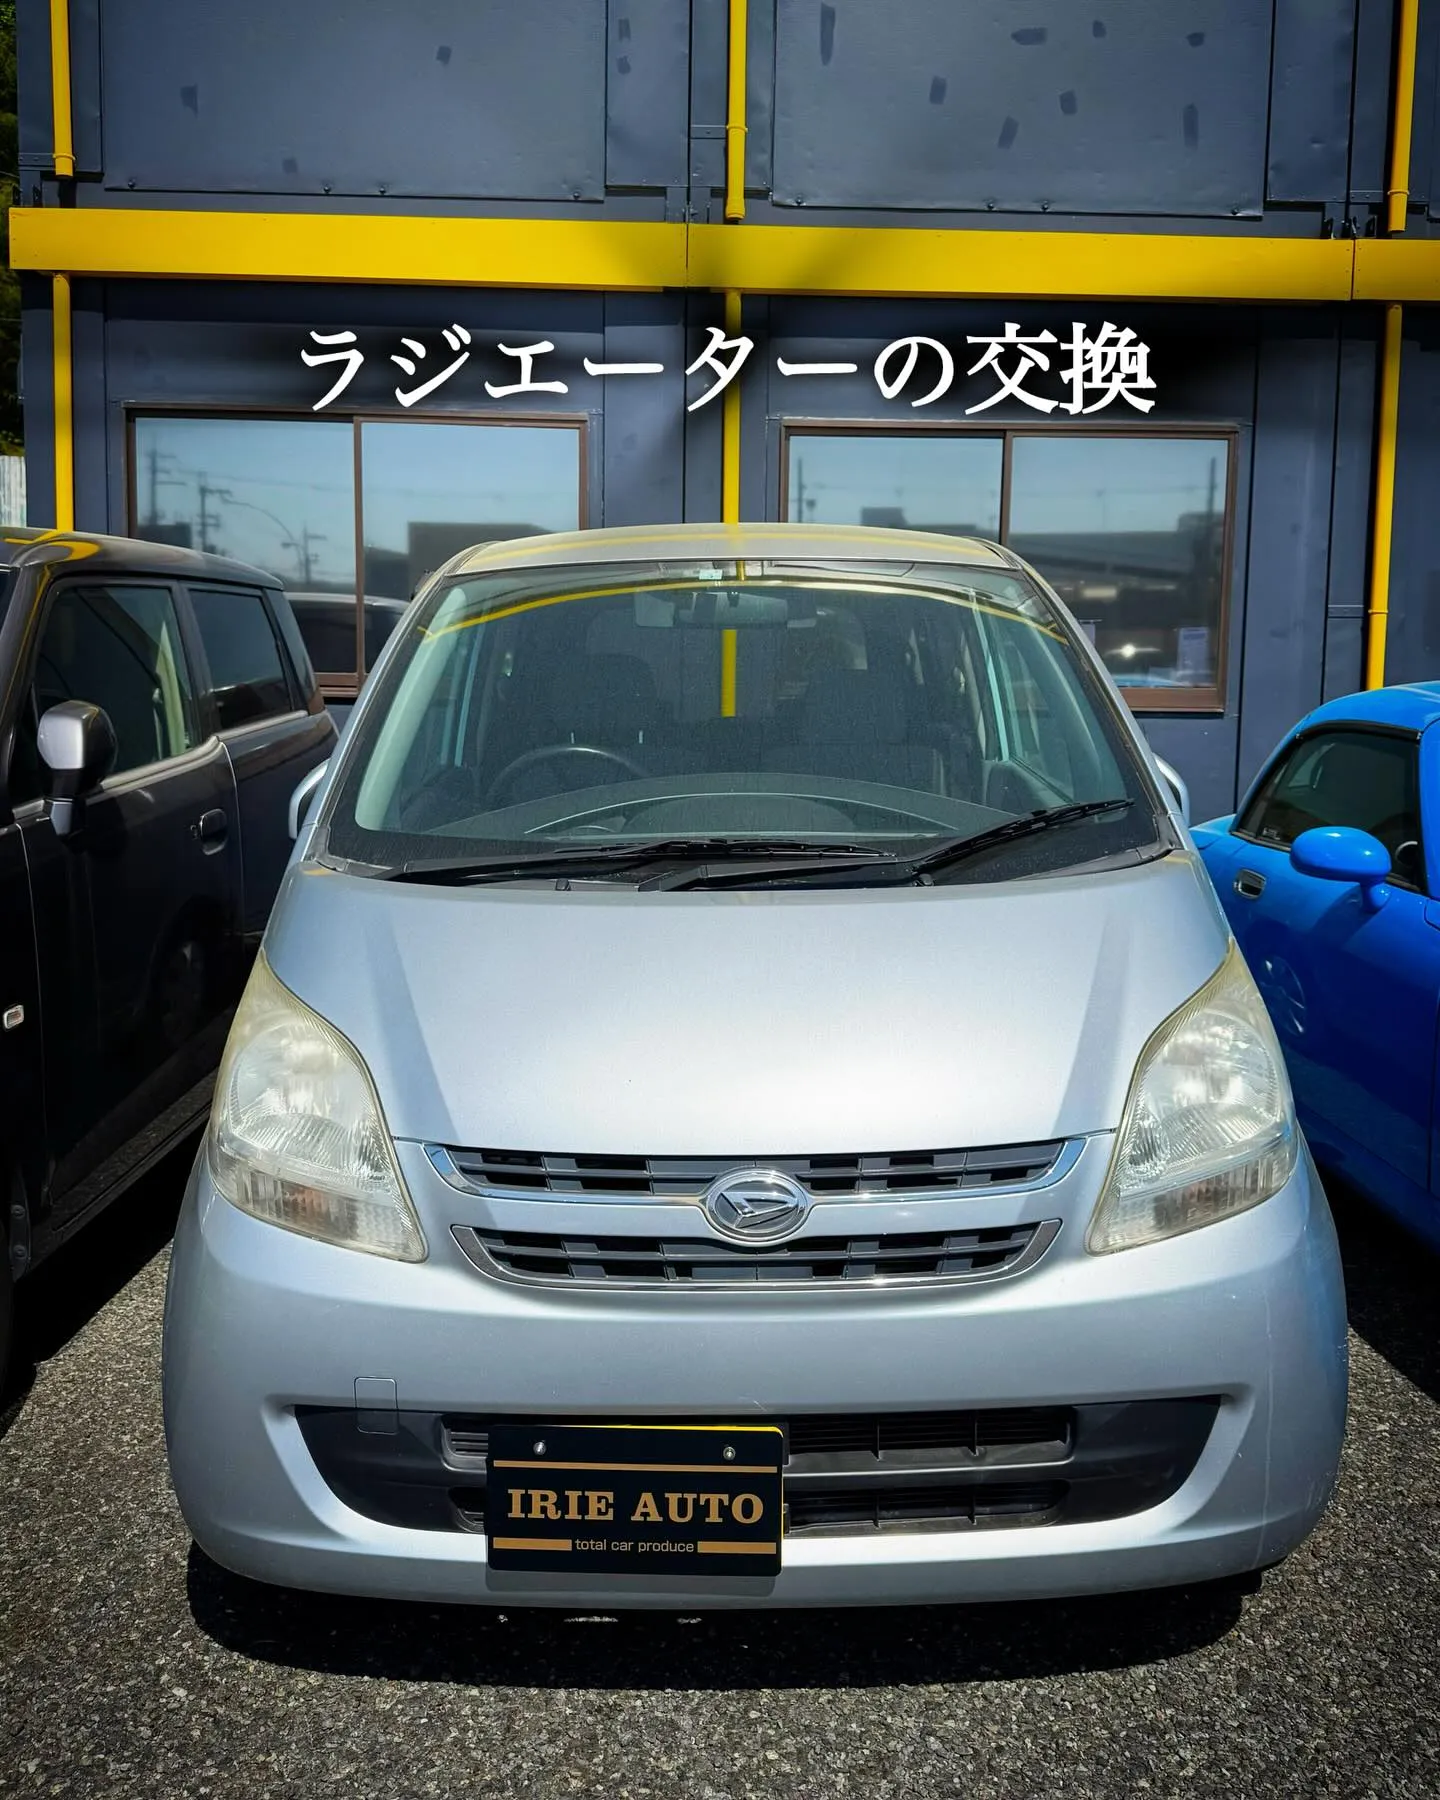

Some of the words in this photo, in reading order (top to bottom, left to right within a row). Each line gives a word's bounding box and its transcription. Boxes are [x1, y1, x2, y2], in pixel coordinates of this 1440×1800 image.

[507, 1488, 614, 1521] IRIE
[630, 1492, 764, 1524] AUTO
[574, 1539, 607, 1551] total
[611, 1541, 634, 1552] car
[638, 1541, 694, 1553] produce
